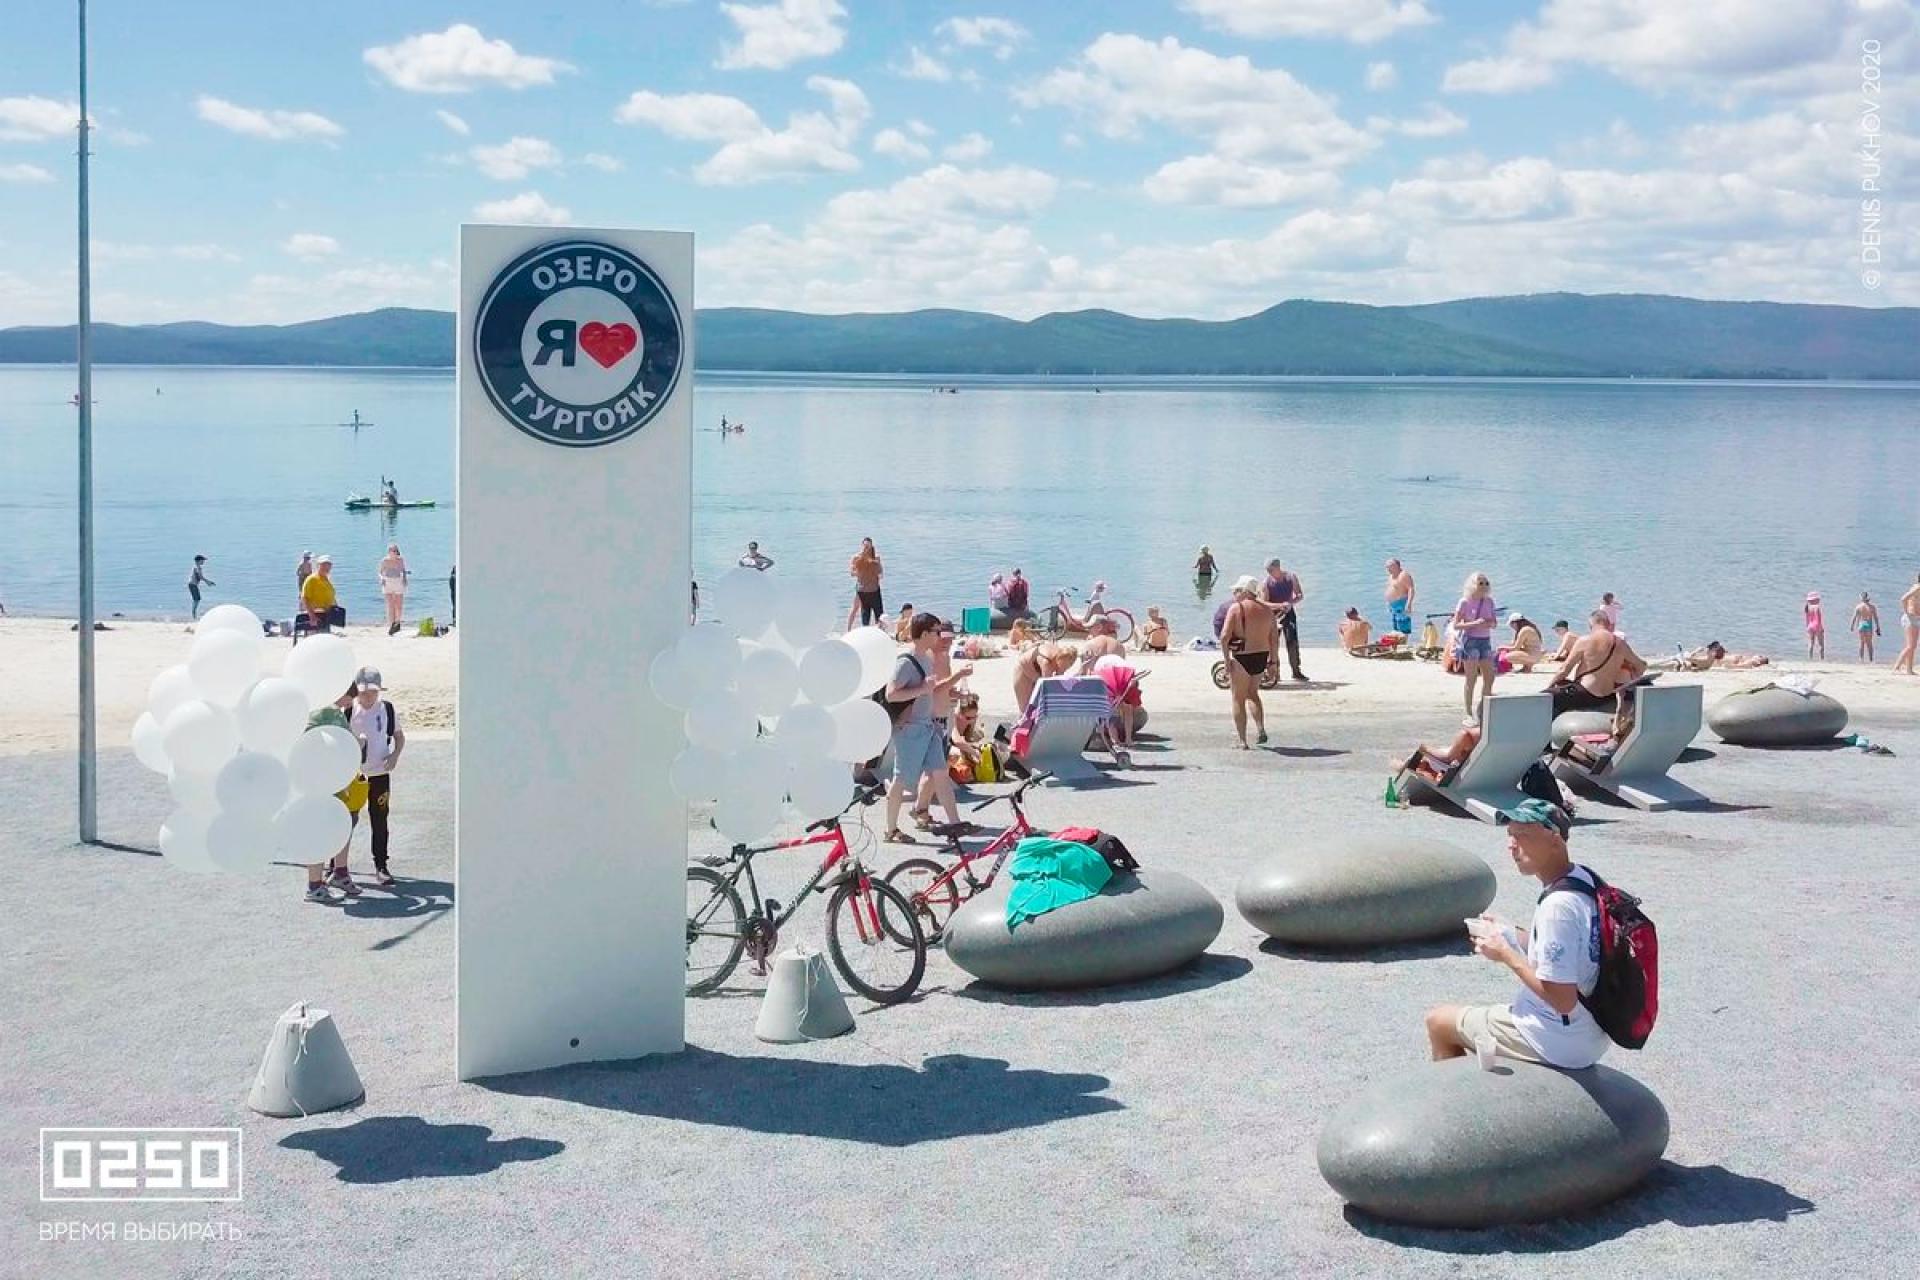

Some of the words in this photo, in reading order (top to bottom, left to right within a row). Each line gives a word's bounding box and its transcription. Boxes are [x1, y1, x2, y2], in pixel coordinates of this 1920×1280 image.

[531, 256, 638, 294] ОЗЕРО
[532, 319, 577, 367] Я
[511, 381, 657, 434] ТУРГОЯК
